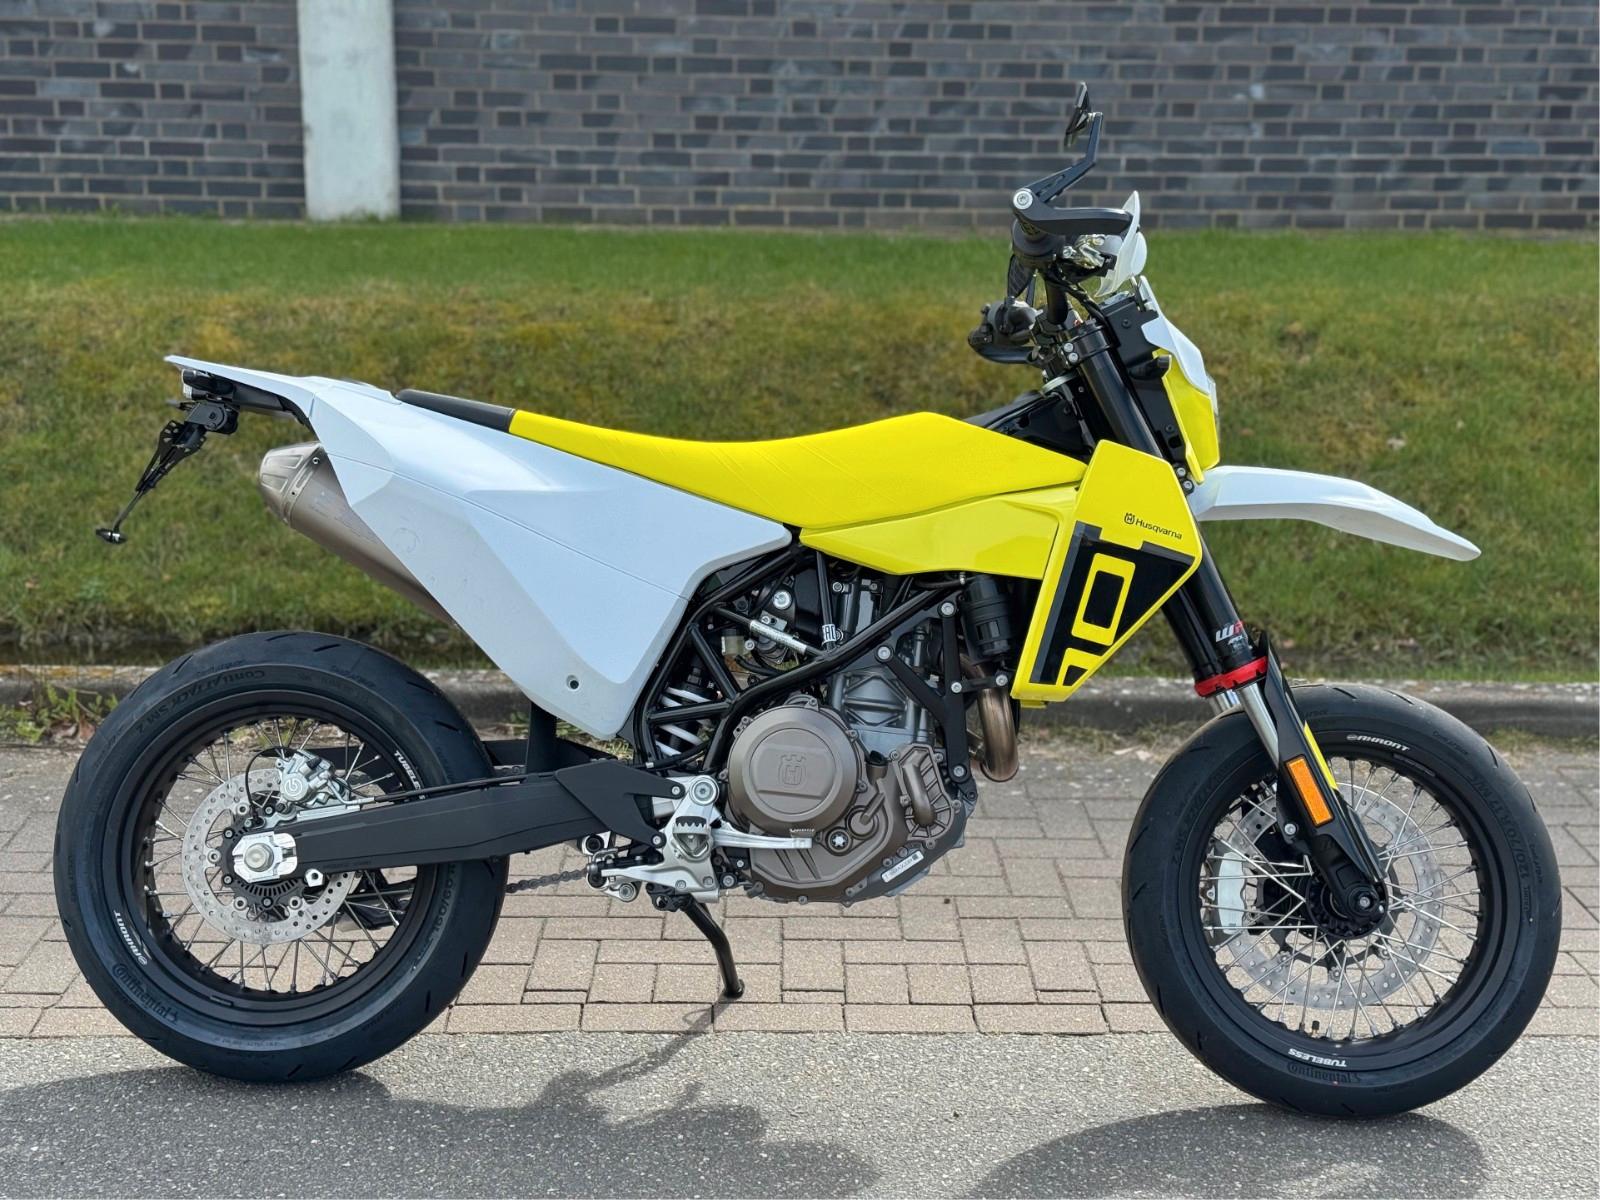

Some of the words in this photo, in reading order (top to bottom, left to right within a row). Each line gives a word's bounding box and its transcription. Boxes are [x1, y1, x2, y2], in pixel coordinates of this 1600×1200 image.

[1135, 518, 1183, 540] Husqvarna
[394, 750, 426, 800] TUBELES
[112, 963, 173, 1018] Continental
[1288, 1048, 1347, 1068] TUBELESS
[1287, 1061, 1351, 1084] Continental
